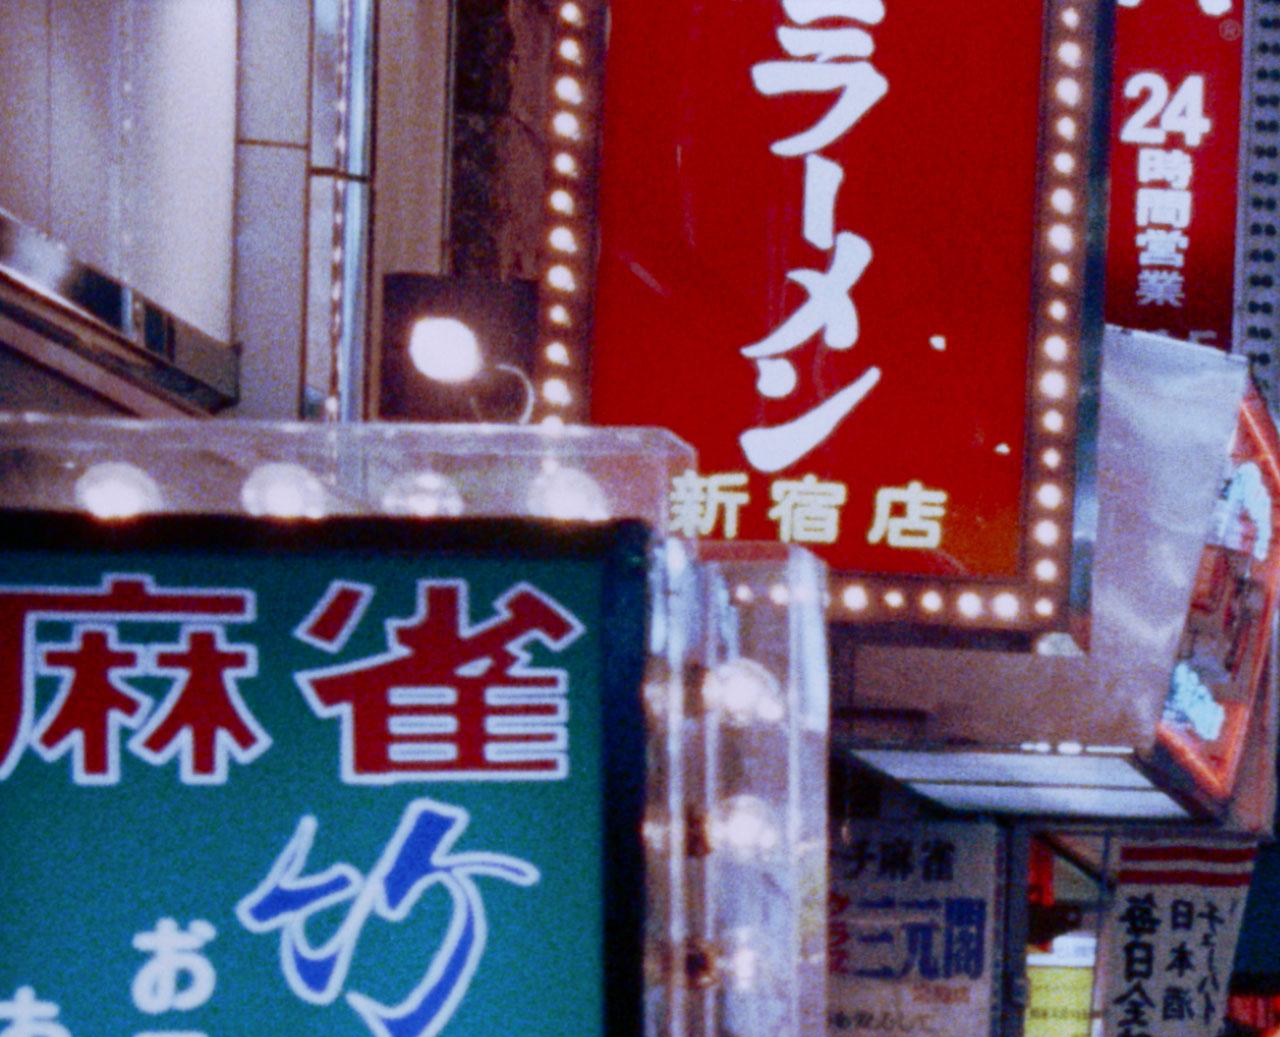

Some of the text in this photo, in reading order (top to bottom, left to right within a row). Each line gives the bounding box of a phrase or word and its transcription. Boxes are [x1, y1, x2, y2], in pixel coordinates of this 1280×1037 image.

[740, 0, 889, 474] ラーメン
[666, 471, 949, 550] 新宿店
[0, 572, 586, 785] 麻雀
